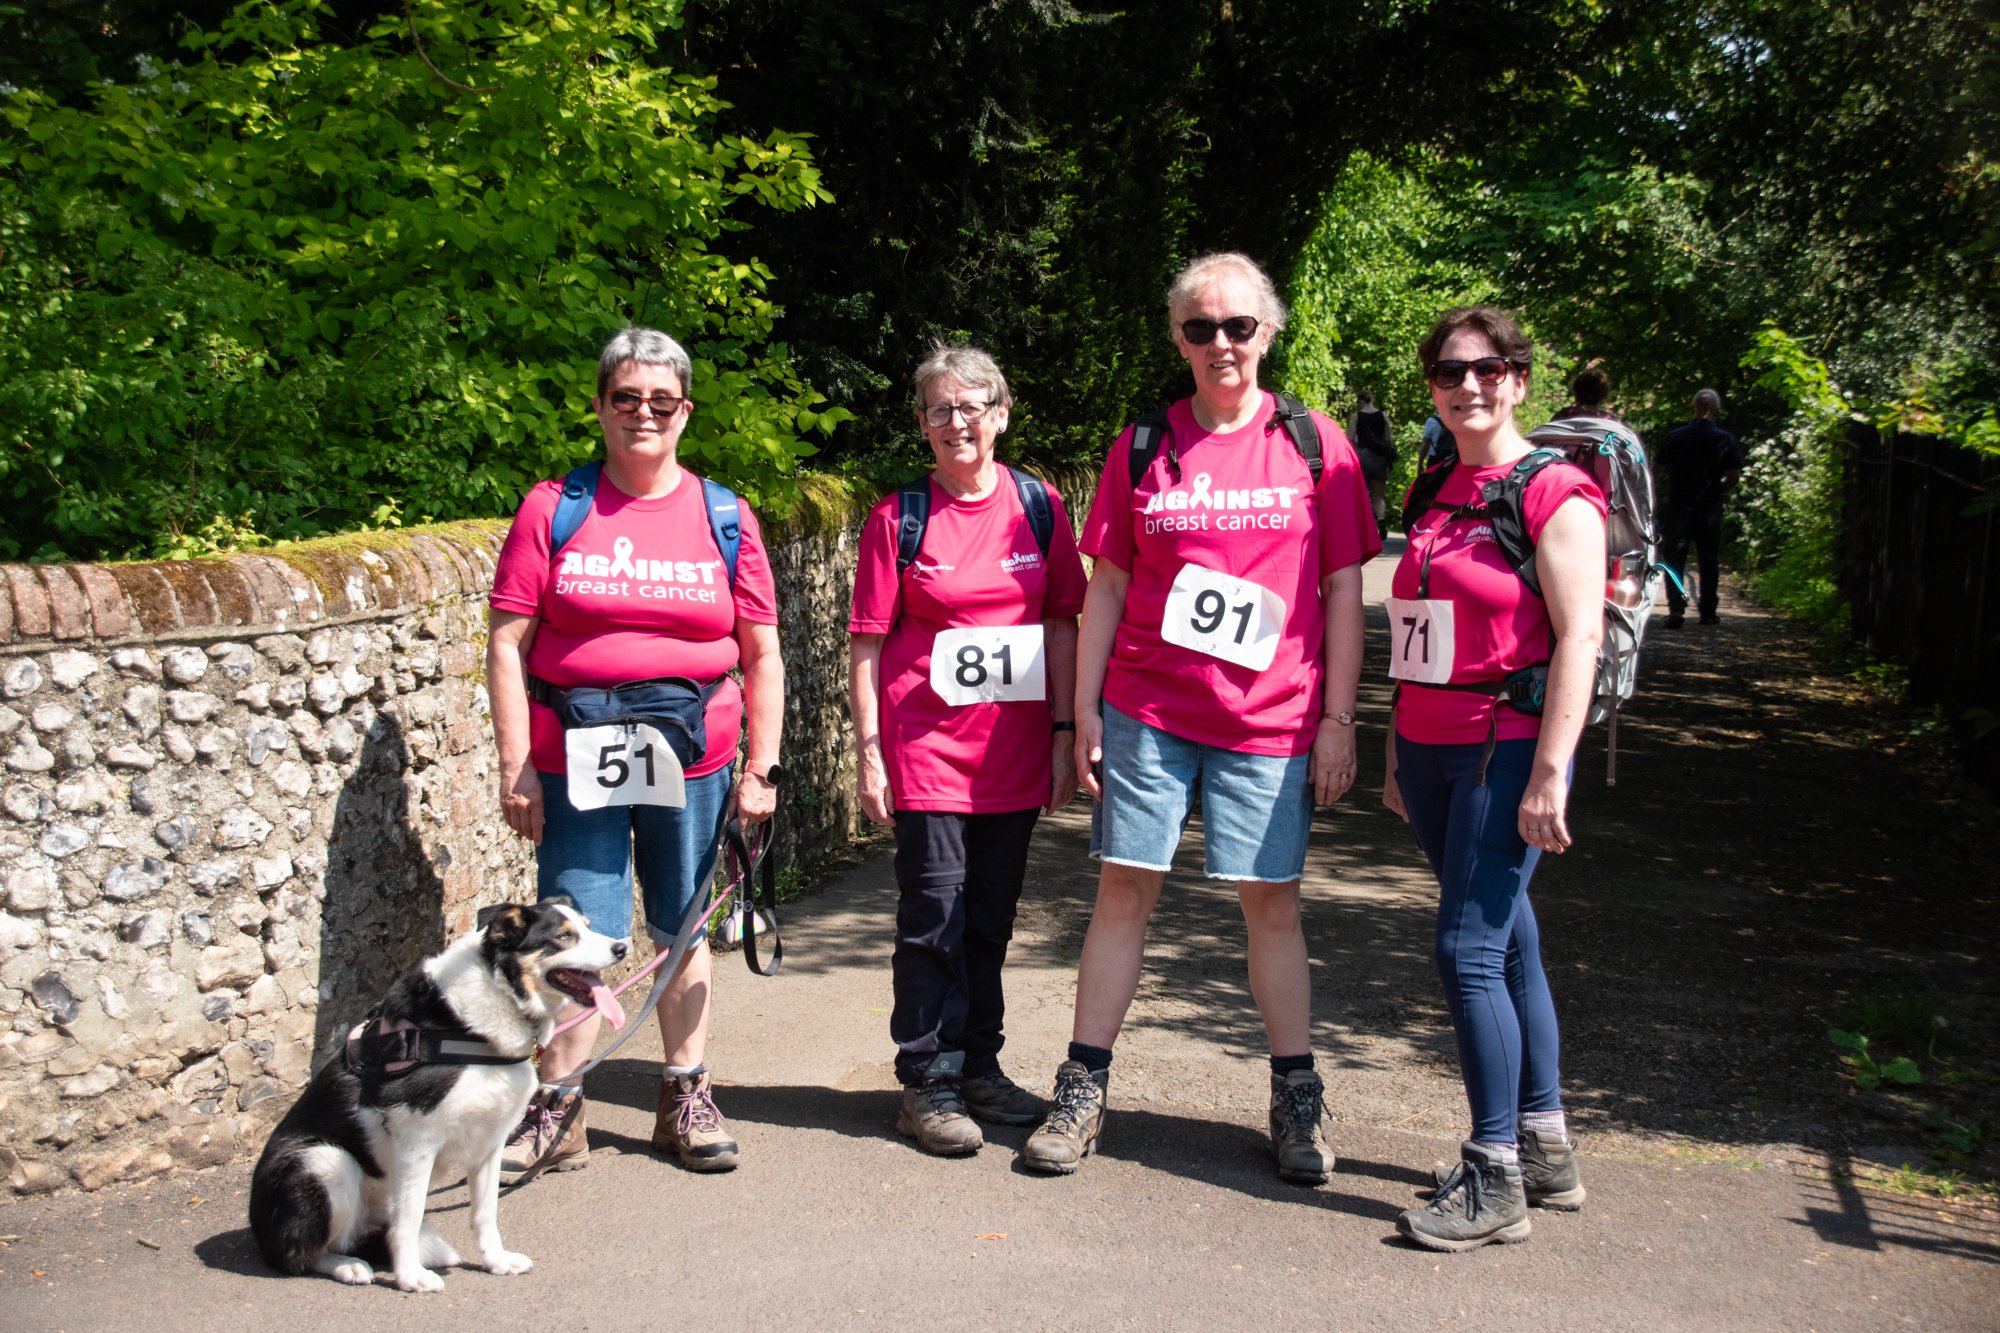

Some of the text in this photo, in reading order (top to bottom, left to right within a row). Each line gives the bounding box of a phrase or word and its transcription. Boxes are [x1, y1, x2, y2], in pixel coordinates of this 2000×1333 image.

[1143, 472, 1294, 514] AGAINST
[1144, 512, 1291, 535] breast cancer
[559, 536, 717, 584] AGAINST
[1003, 564, 1025, 573] breast
[555, 575, 717, 604] breast cancer
[1190, 588, 1255, 646] 91
[1401, 616, 1429, 665] 71
[955, 644, 1012, 688] 81
[596, 743, 656, 789] 51
